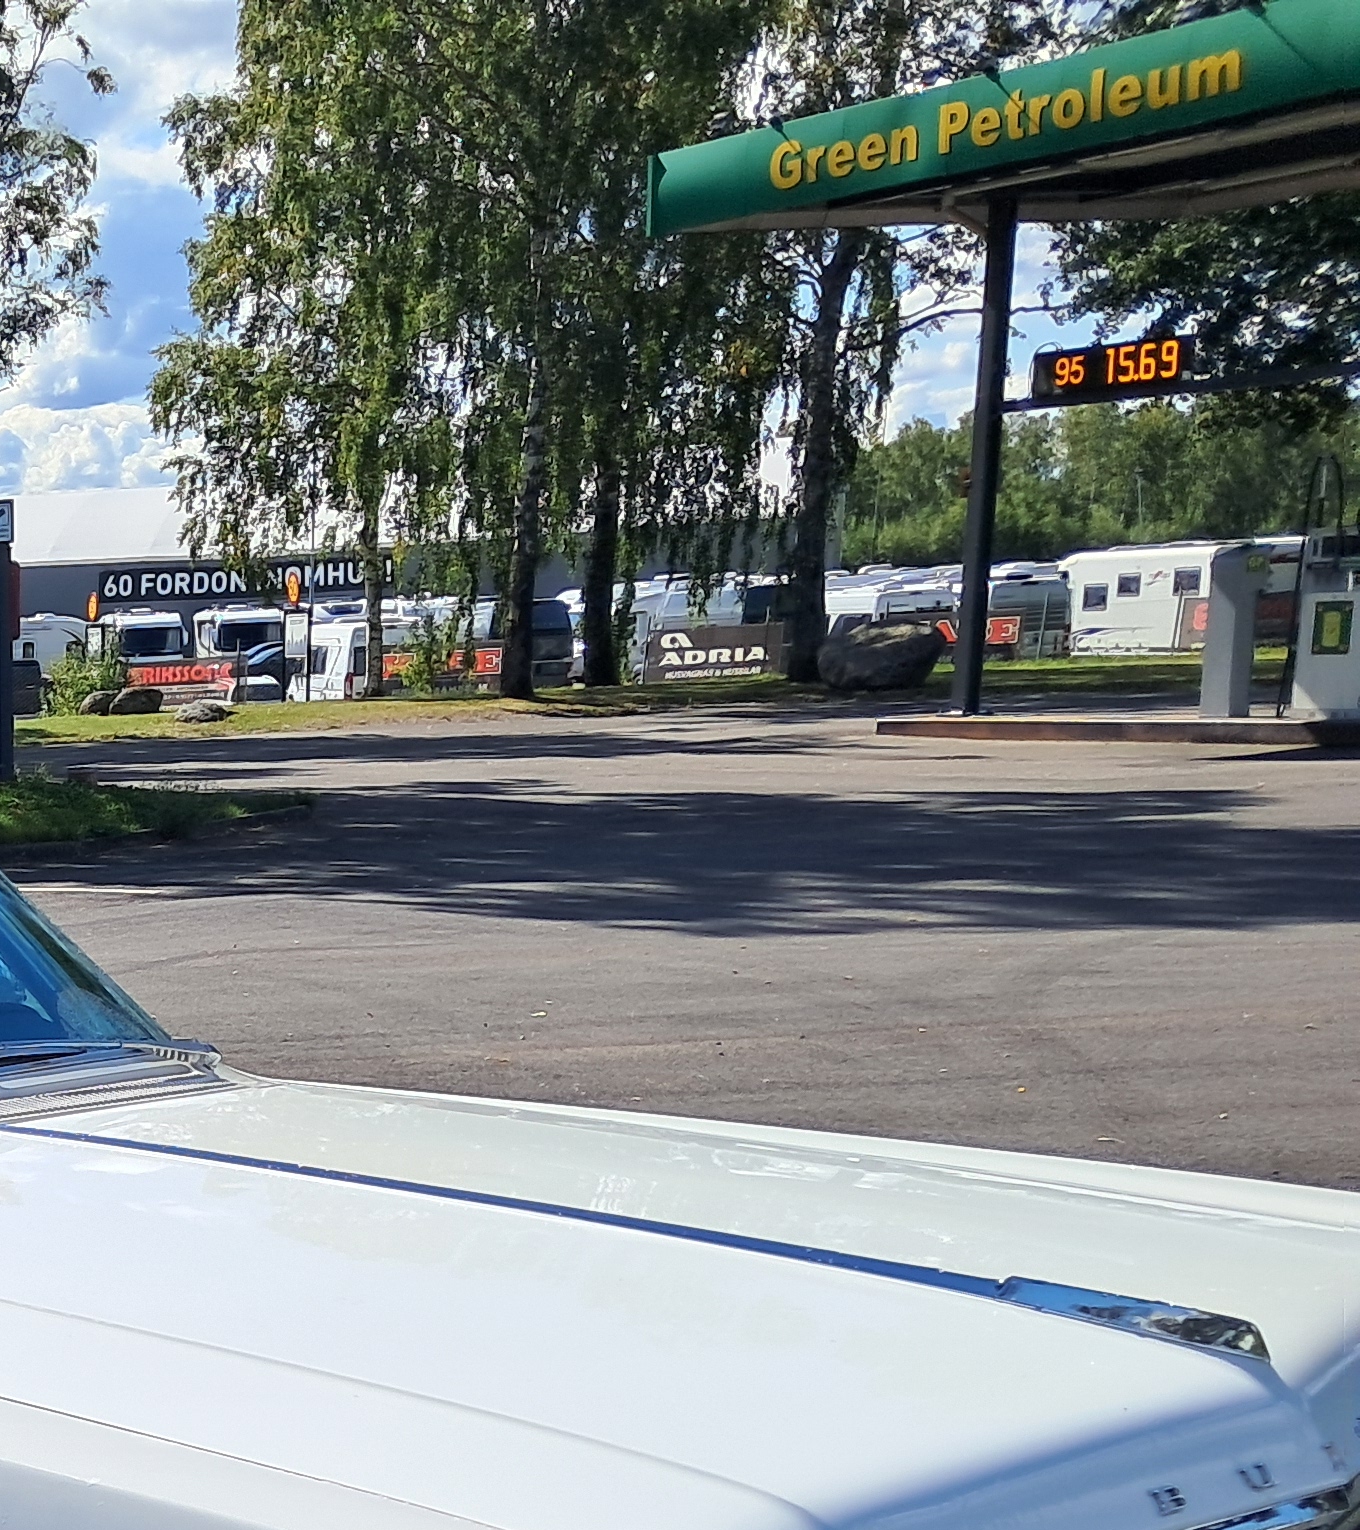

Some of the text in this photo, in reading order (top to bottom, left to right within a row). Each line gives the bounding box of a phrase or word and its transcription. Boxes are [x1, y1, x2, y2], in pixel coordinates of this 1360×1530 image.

[769, 48, 1243, 190] Green Petroleum
[1055, 339, 1179, 387] 95 15.69
[102, 569, 134, 598] 60
[140, 567, 248, 597] FORDON
[658, 646, 765, 667] ADRIA
